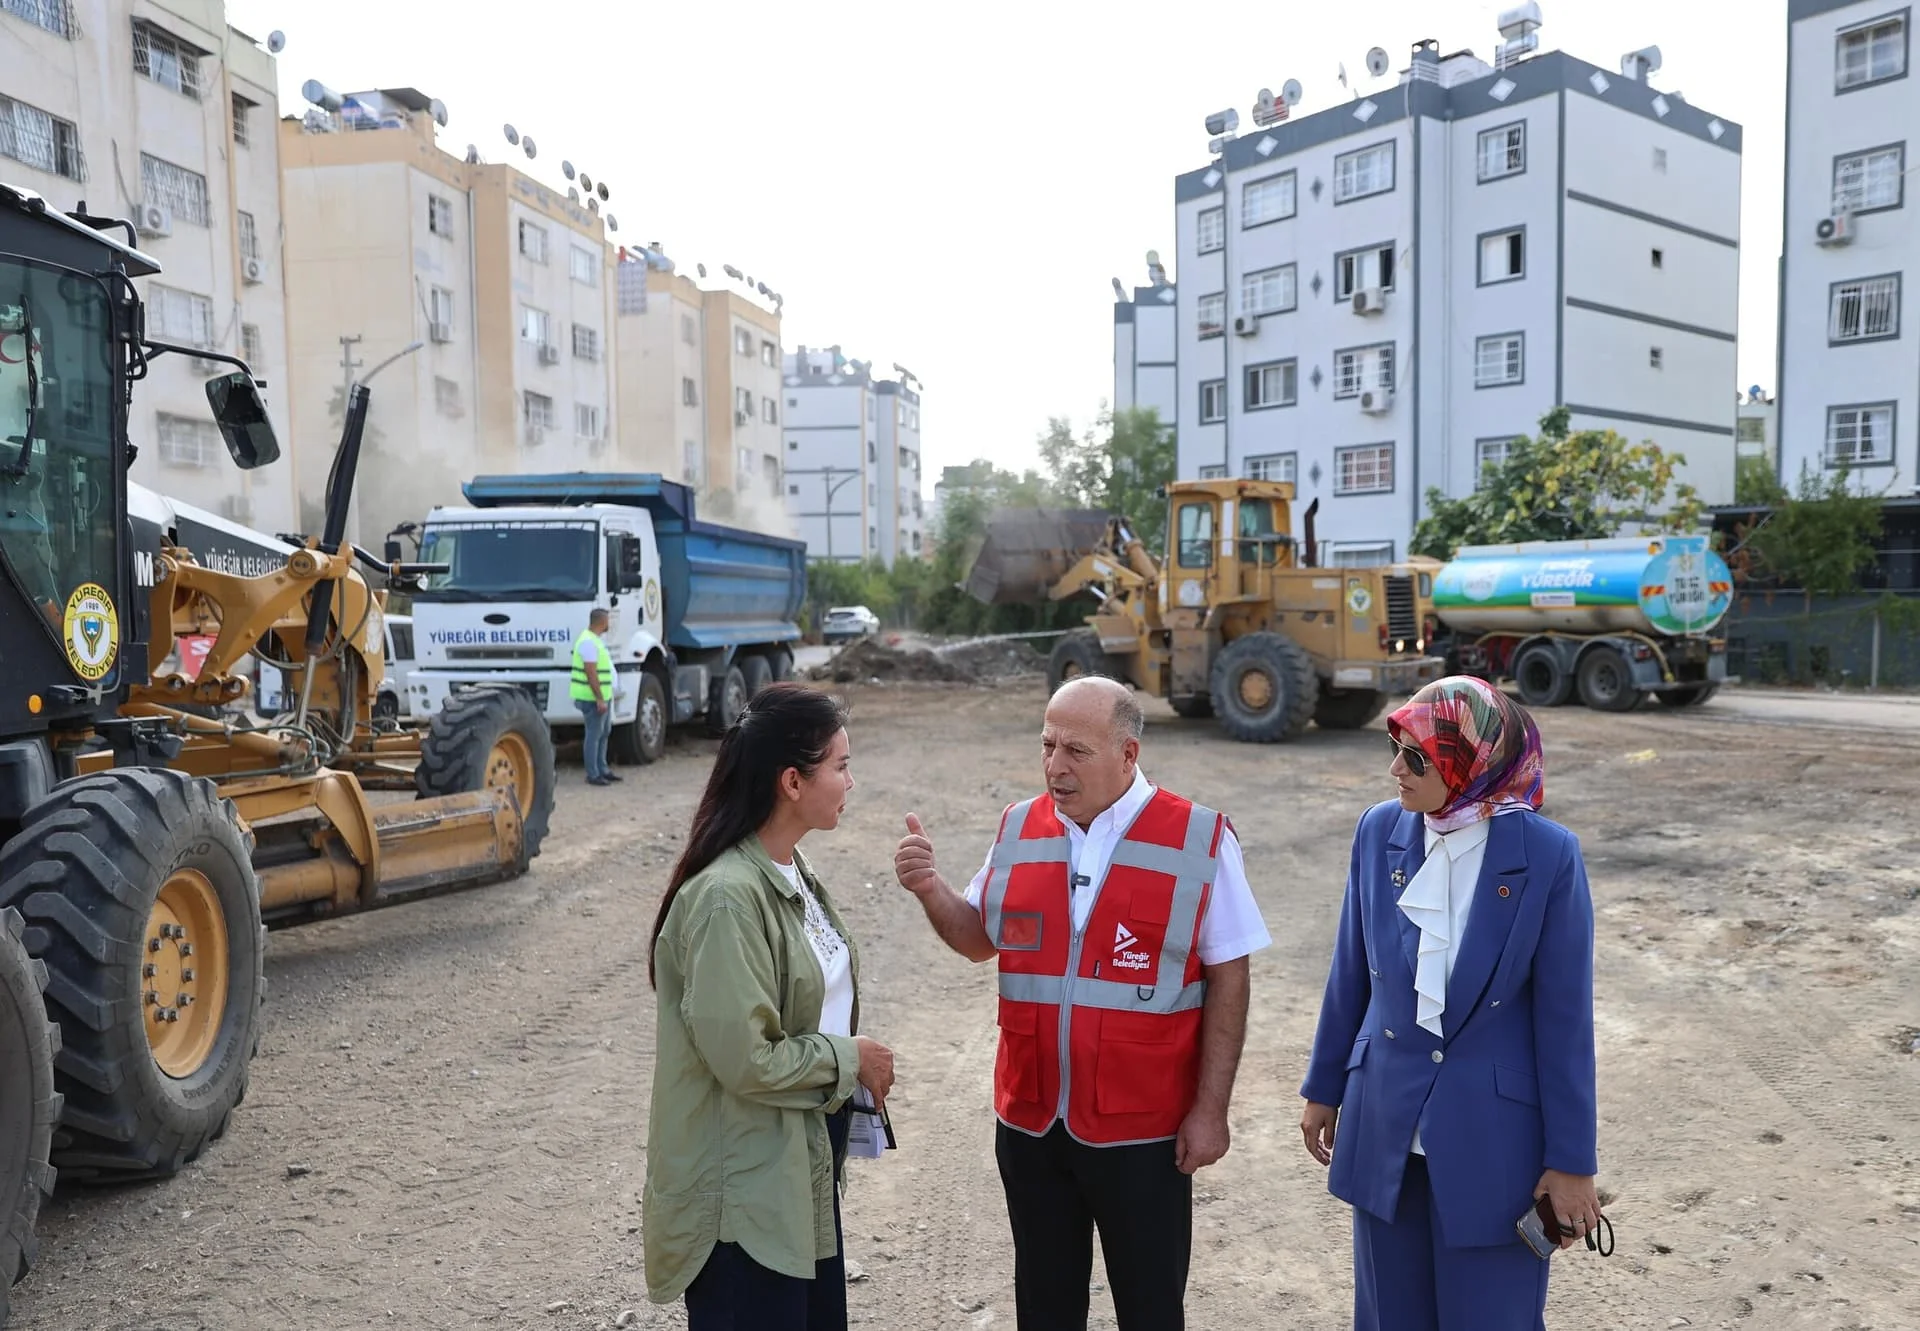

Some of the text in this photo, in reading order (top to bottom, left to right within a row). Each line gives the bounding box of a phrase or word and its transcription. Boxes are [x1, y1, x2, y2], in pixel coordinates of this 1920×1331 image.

[430, 628, 570, 644] YÜREĞİR BELEDİYESİ
[1122, 950, 1150, 962] Yüreğir
[1112, 958, 1150, 970] Belediyesi
